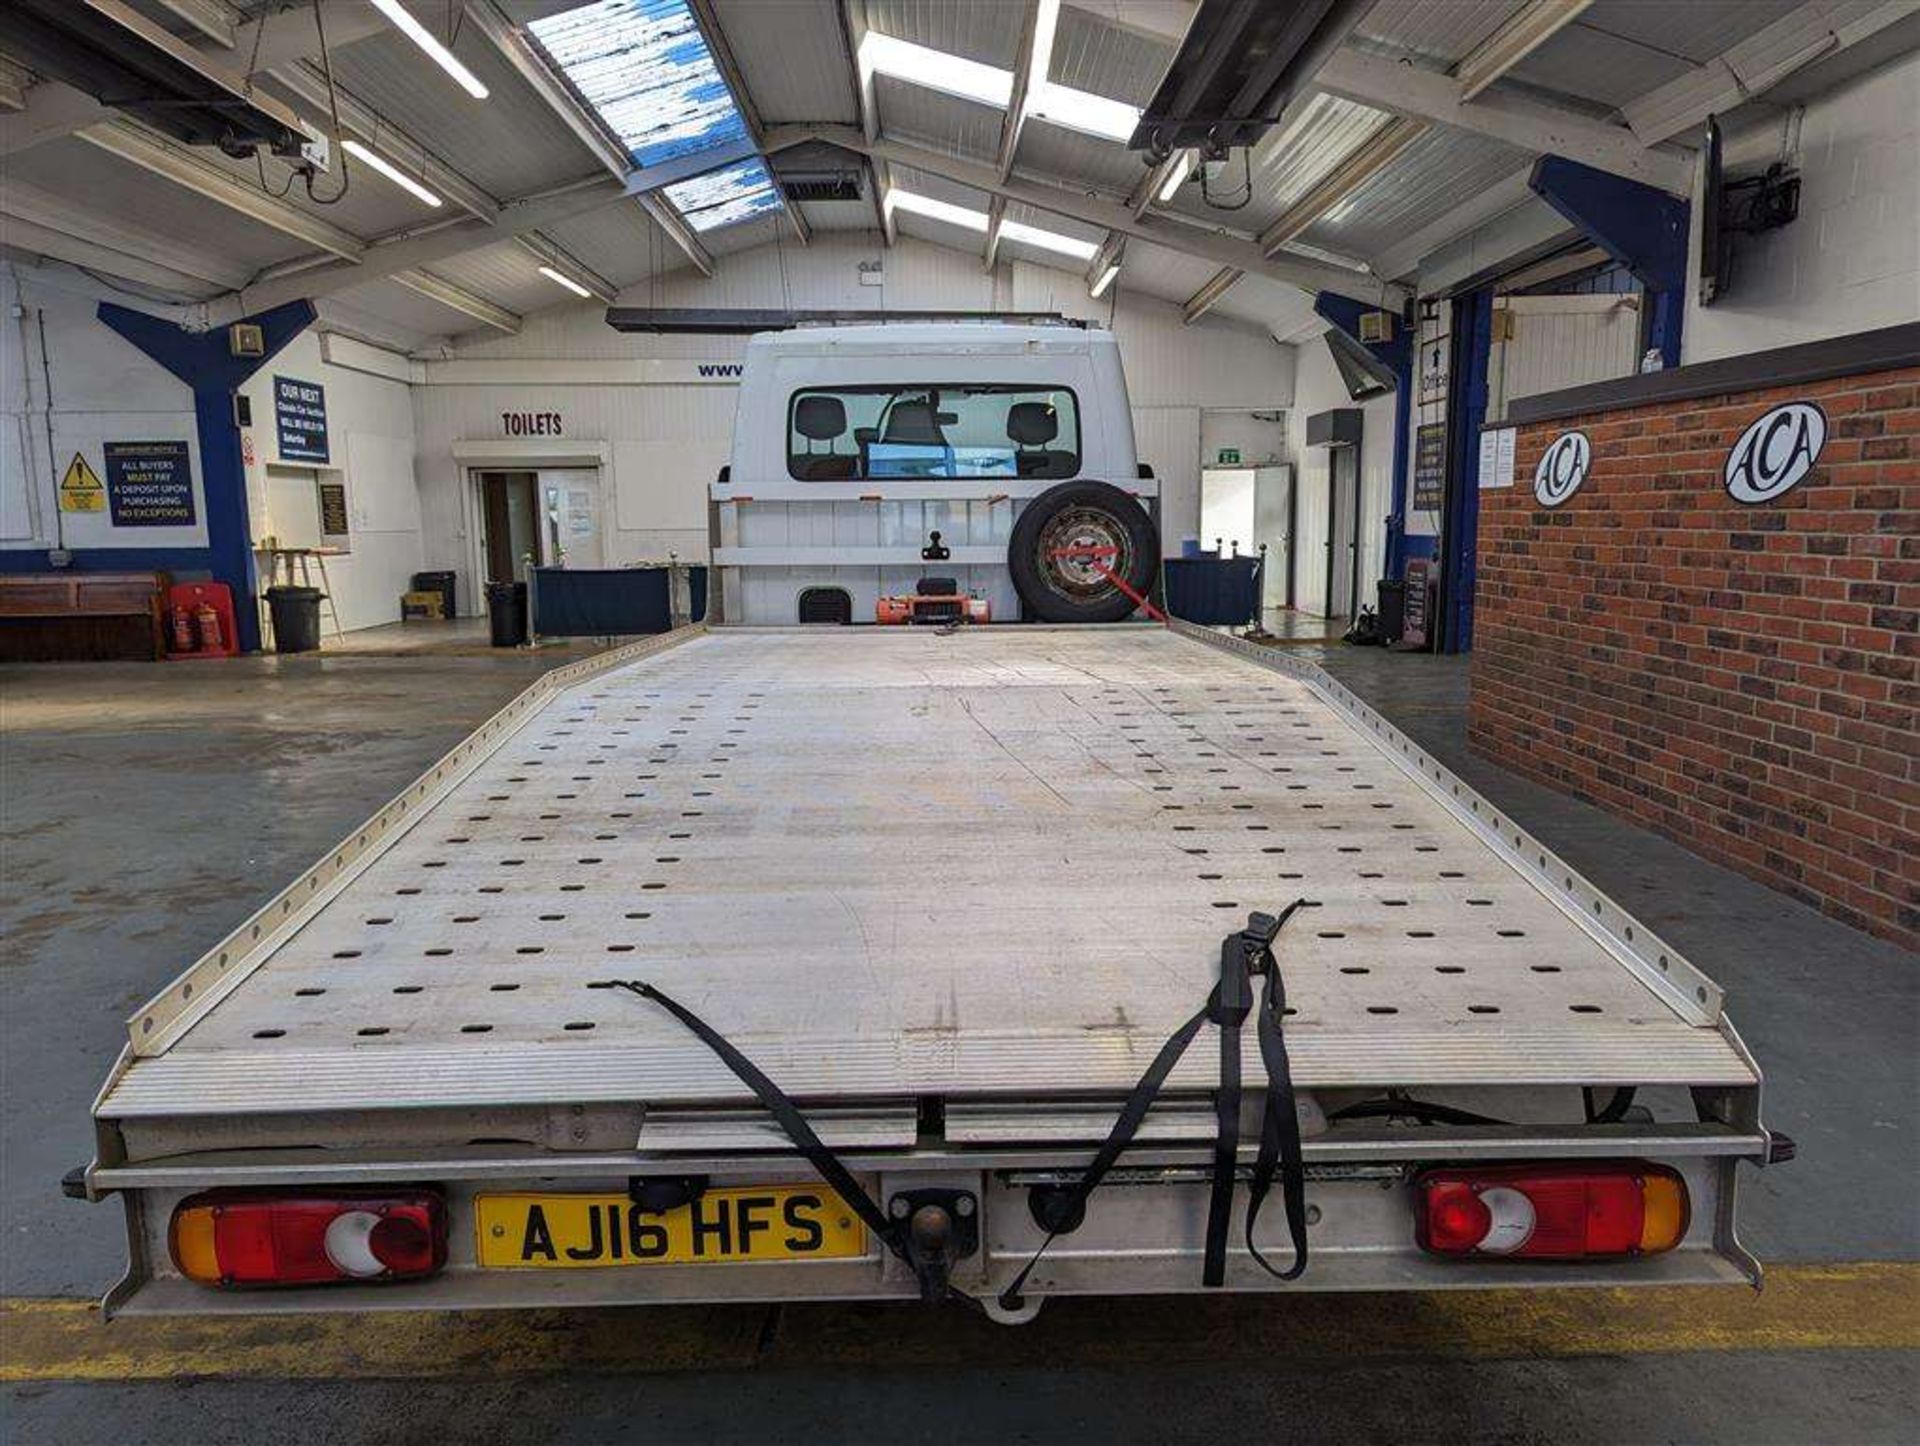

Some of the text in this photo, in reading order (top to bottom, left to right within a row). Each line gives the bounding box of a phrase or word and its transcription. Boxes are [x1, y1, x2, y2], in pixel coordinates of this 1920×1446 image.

[281, 383, 319, 402] OUR NEXT
[502, 412, 562, 435] TOILETS
[1725, 411, 1813, 492] ACA
[122, 461, 174, 470] ALL BUYERS
[1536, 438, 1583, 498] ACA
[127, 473, 171, 482] MUST PAY
[114, 484, 188, 495] A DEPOSIT UPON
[122, 496, 182, 506] PURCHASING
[118, 507, 189, 517] NO EXCEPTIONS
[521, 1194, 823, 1260] AJ16 HFS
